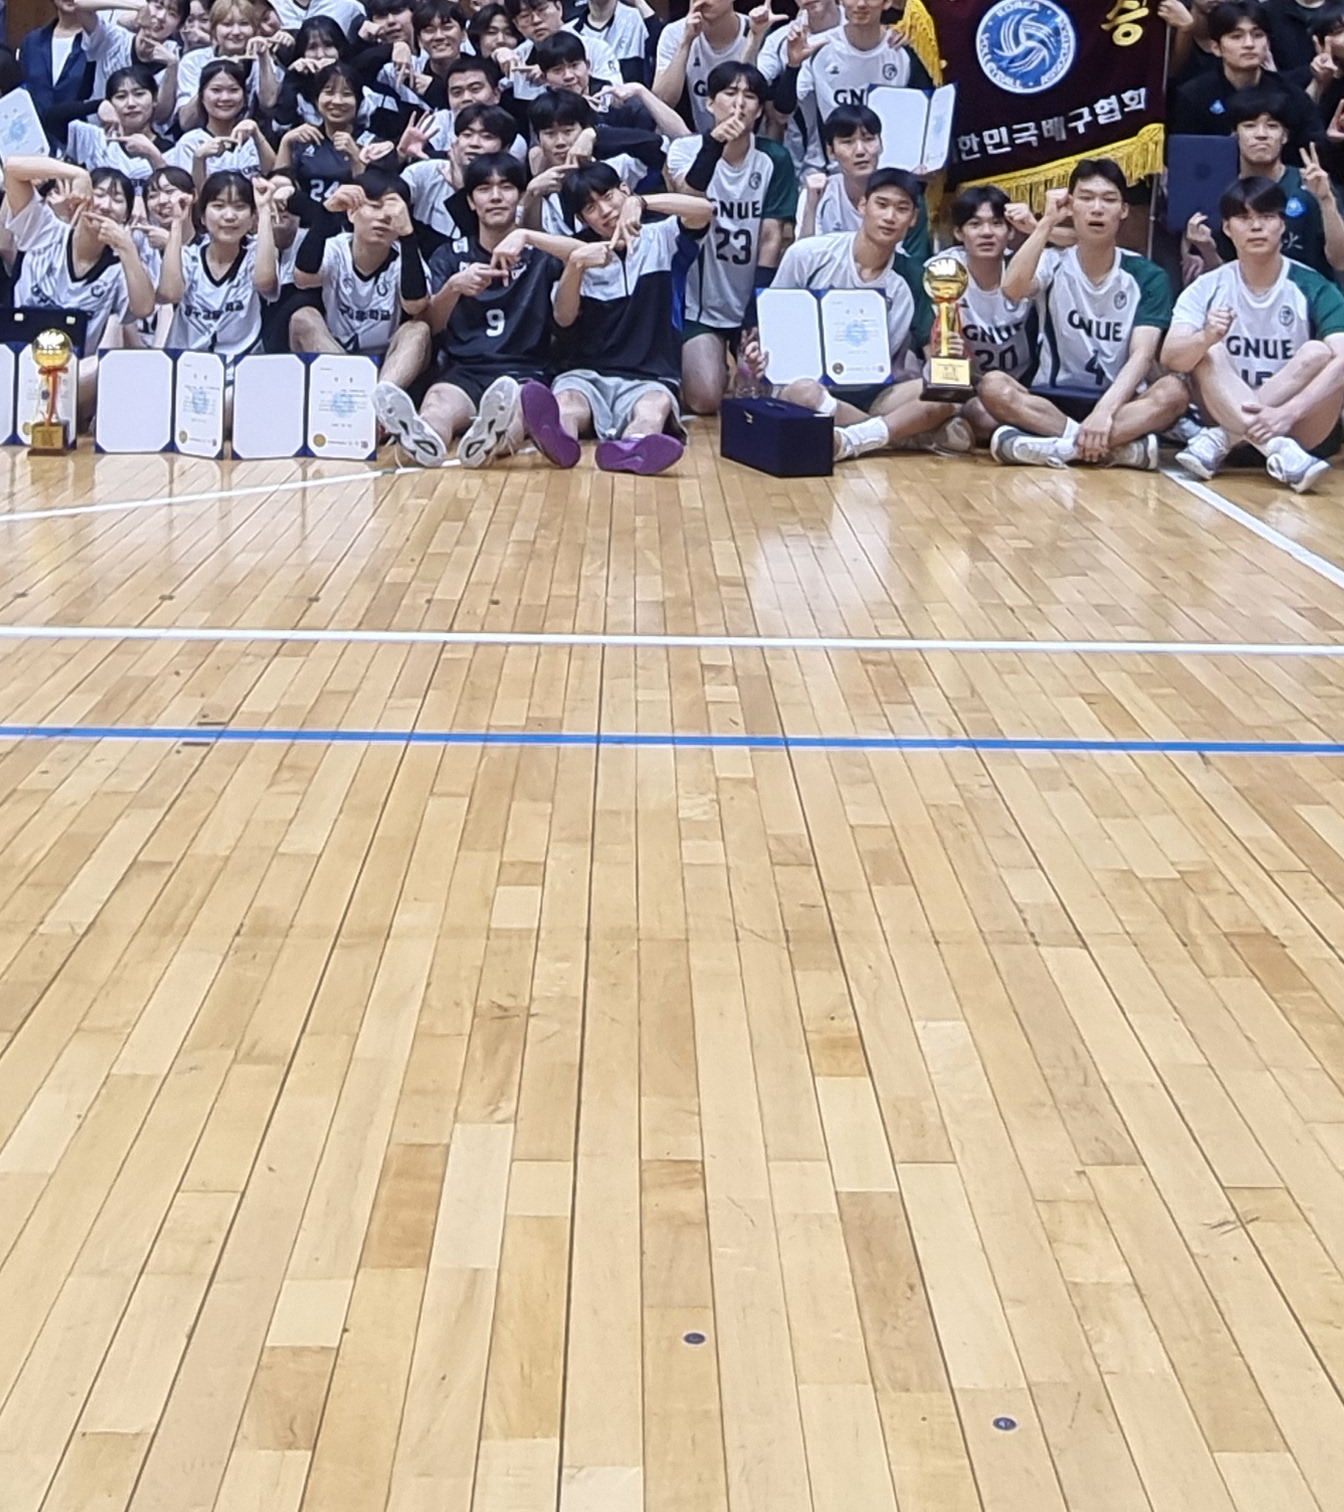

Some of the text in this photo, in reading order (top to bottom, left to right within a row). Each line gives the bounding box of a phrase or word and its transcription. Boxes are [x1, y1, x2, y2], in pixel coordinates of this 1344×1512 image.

[997, 0, 1040, 18] KOREA
[954, 87, 1148, 162] 한민국배구협회
[714, 226, 752, 266] 23
[485, 308, 506, 338] 9
[1225, 335, 1294, 360] GNUE
